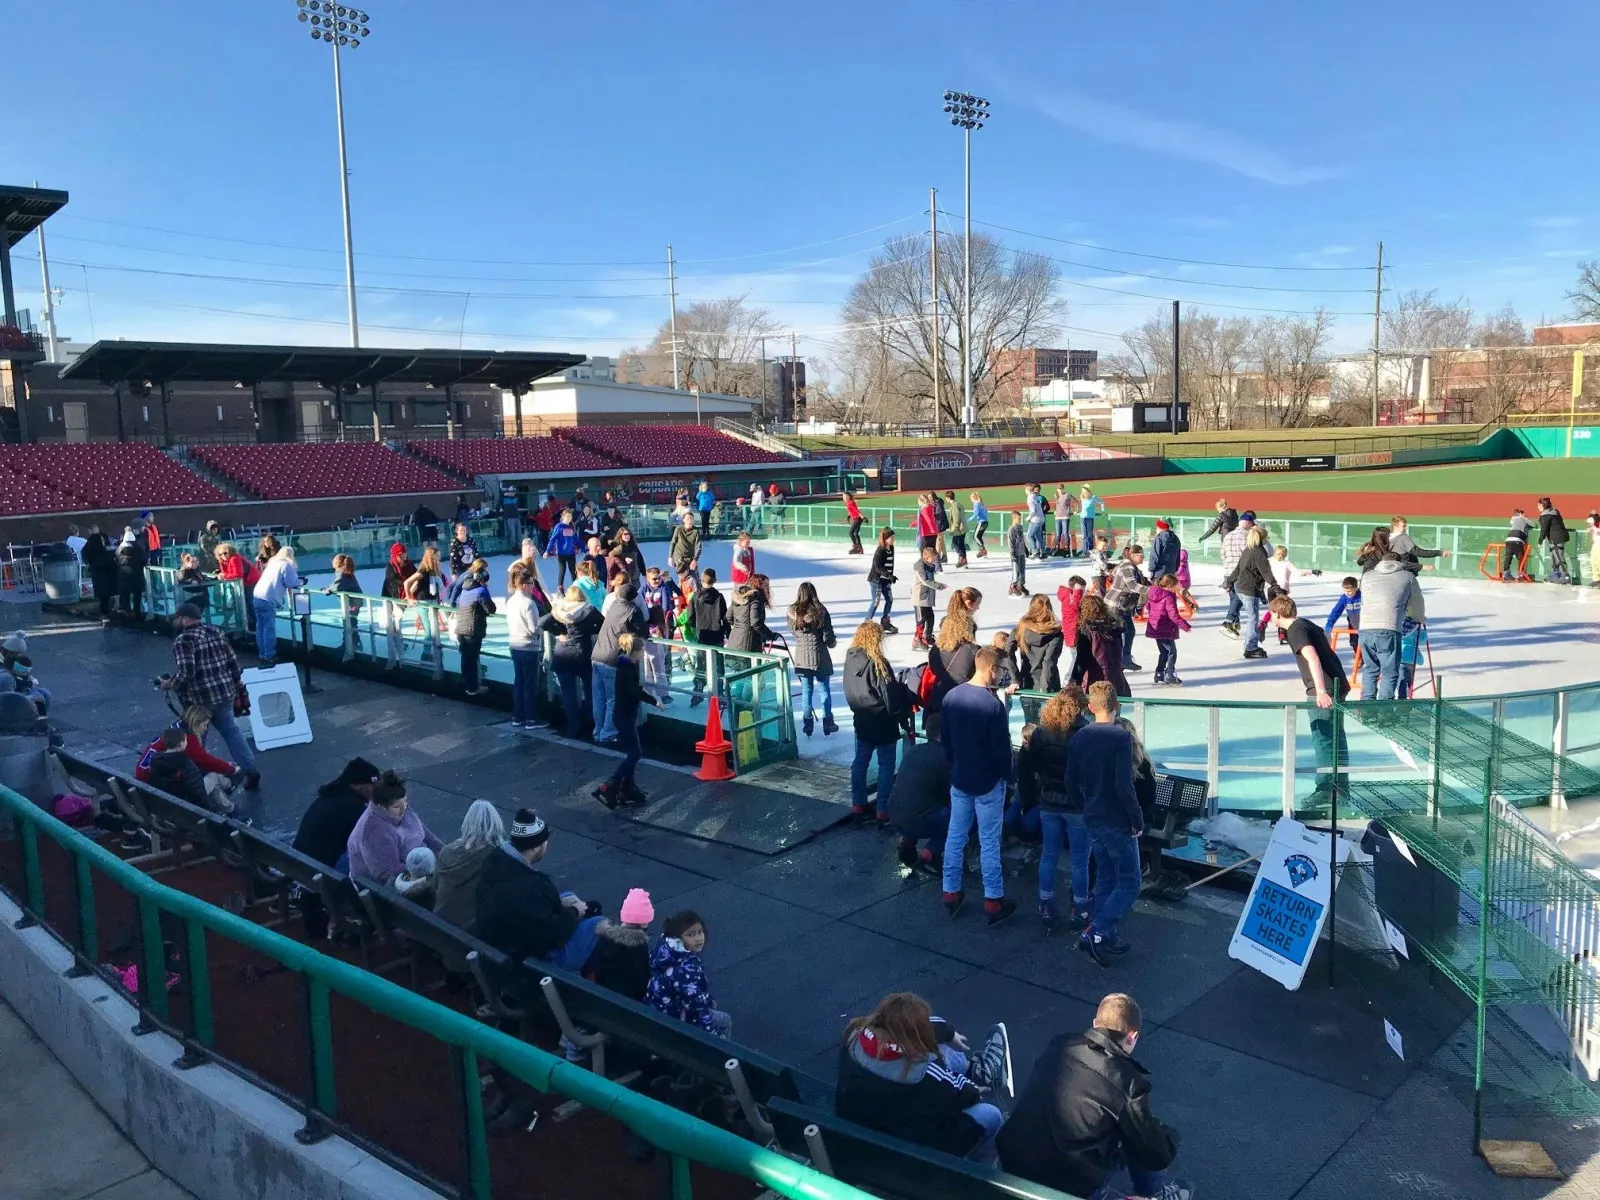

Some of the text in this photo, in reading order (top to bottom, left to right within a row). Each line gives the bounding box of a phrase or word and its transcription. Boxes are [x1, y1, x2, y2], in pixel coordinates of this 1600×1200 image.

[920, 456, 965, 469] Solidarity
[1251, 458, 1290, 467] PURDUE
[1261, 886, 1316, 921] RETURN
[1256, 903, 1308, 938] SKATES
[1257, 923, 1294, 952] HERE
